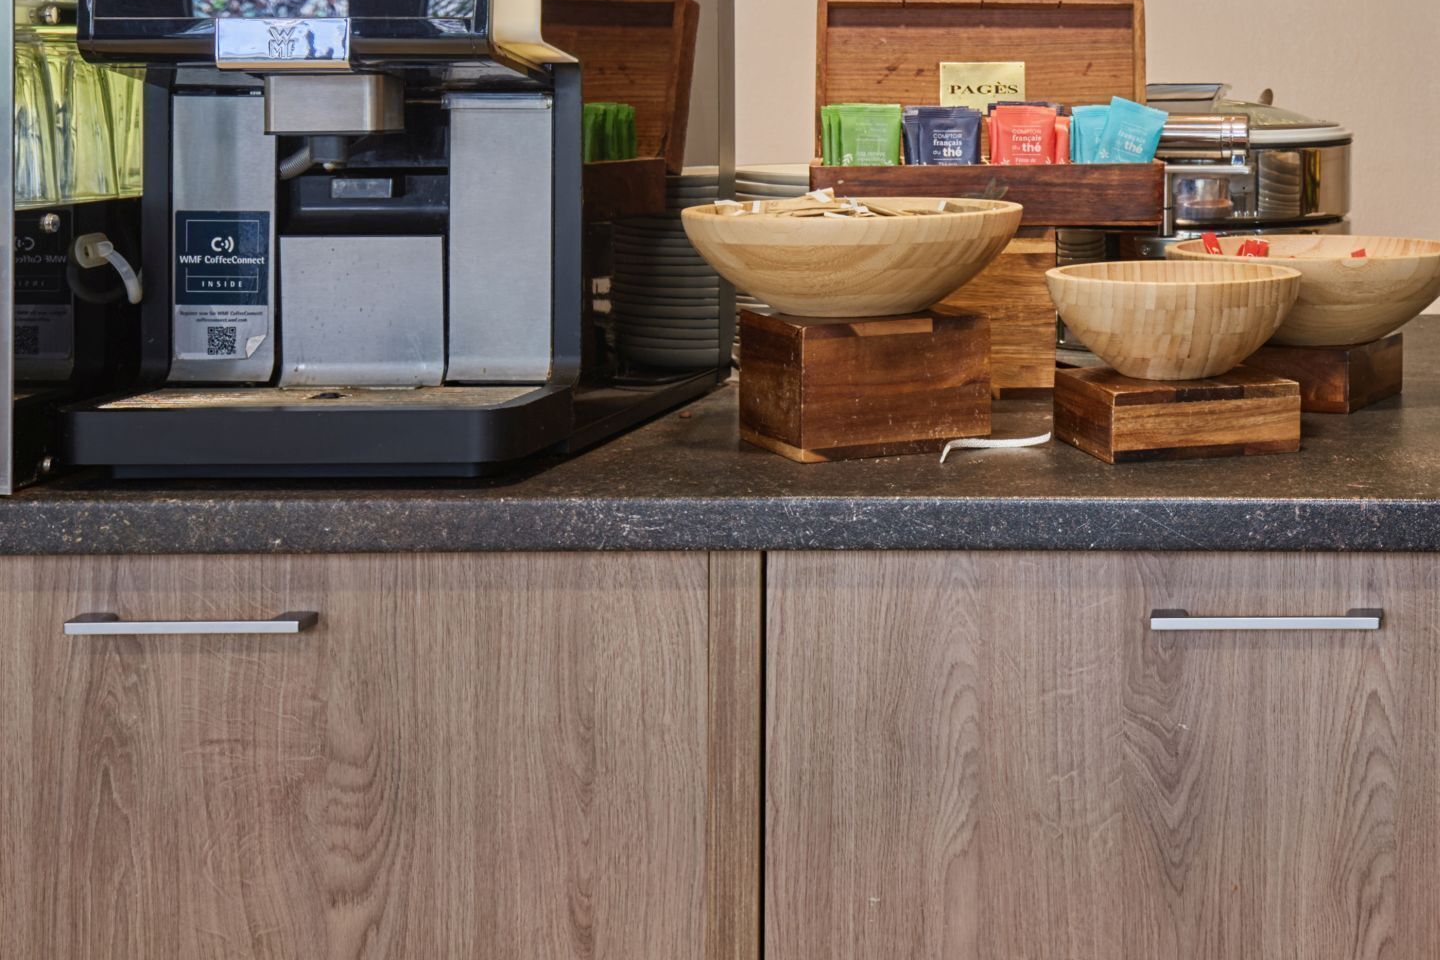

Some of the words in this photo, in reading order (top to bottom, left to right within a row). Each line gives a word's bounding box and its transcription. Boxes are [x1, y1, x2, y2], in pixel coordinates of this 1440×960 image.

[950, 81, 1019, 94] PAGÈS
[932, 139, 963, 147] français
[1011, 134, 1042, 143] français
[942, 146, 963, 157] thé
[1021, 142, 1042, 152] thé
[179, 255, 203, 264] WMF
[204, 255, 265, 264] CoffeeConnect
[201, 280, 243, 288] INSIDE
